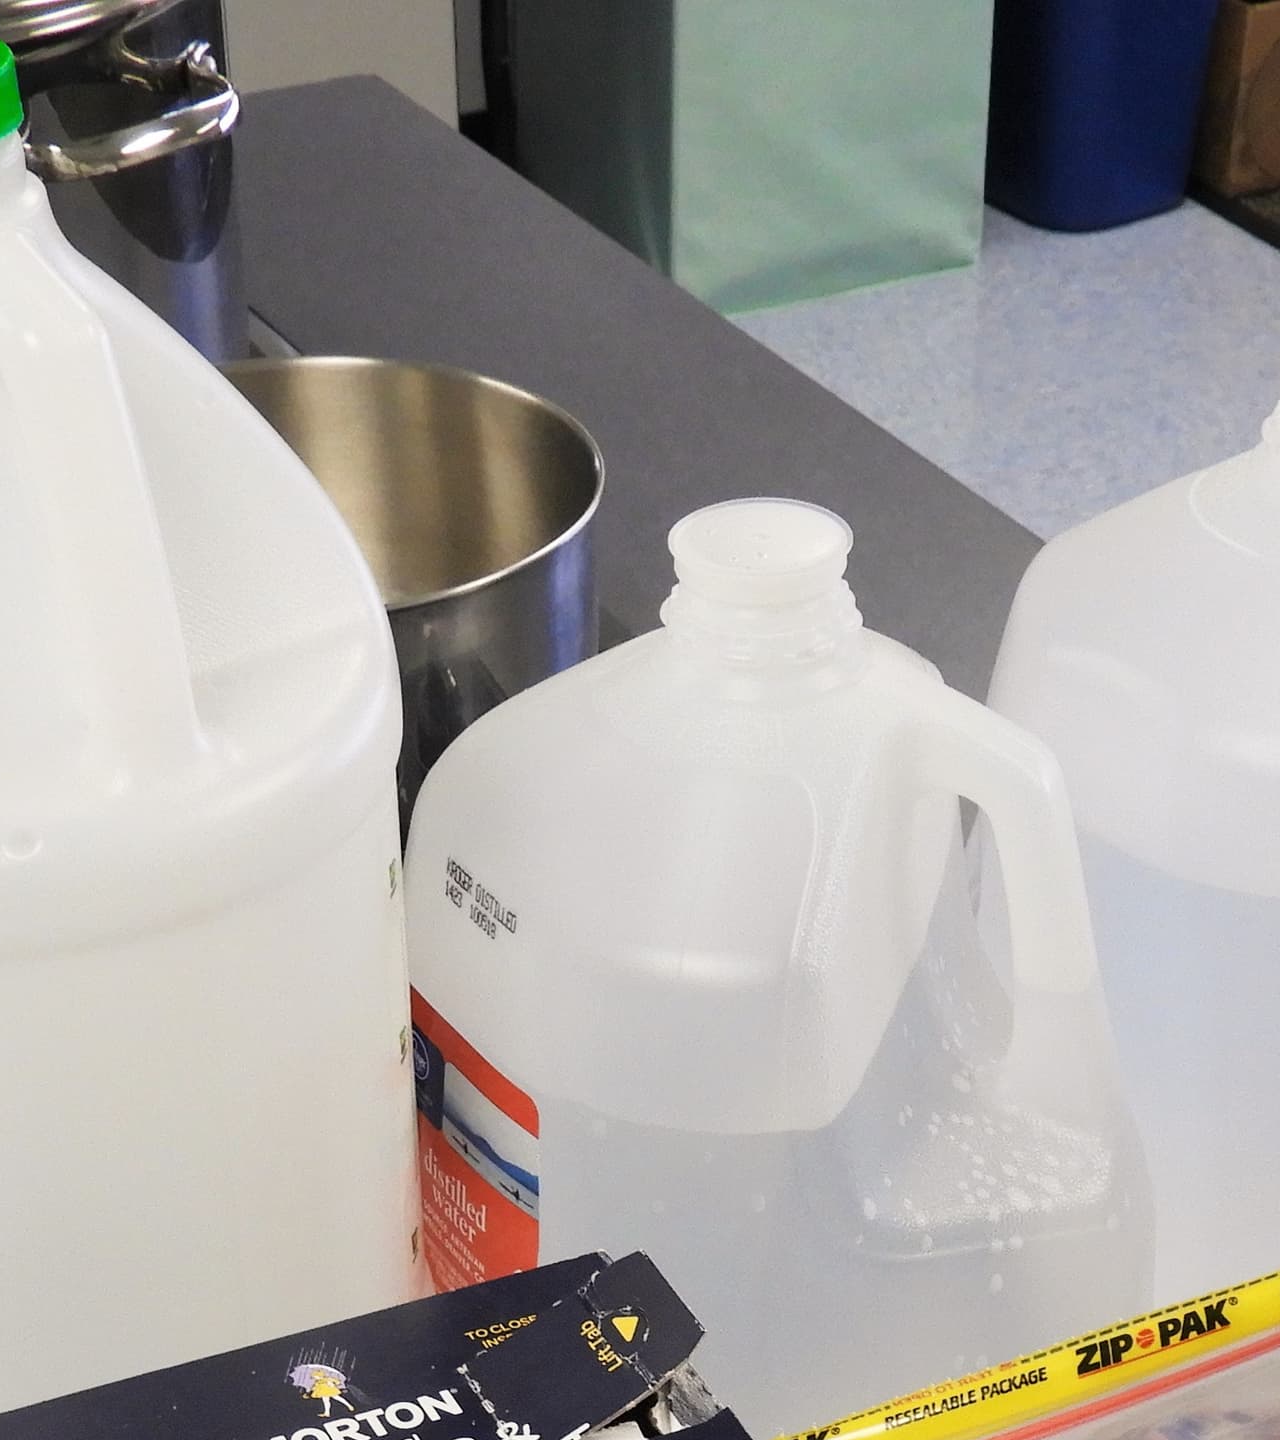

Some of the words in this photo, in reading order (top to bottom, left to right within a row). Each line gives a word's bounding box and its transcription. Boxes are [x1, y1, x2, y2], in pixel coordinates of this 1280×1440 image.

[424, 1148, 486, 1232] distilled
[432, 1184, 476, 1243] water
[464, 1329, 488, 1341] TO
[580, 1320, 605, 1350] Tab
[598, 1343, 623, 1372] Lift
[1075, 1333, 1133, 1375] ZIP
[1158, 1298, 1231, 1348] PAK
[884, 1389, 976, 1431] RESEALABLE
[980, 1367, 1048, 1400] PACKAGE
